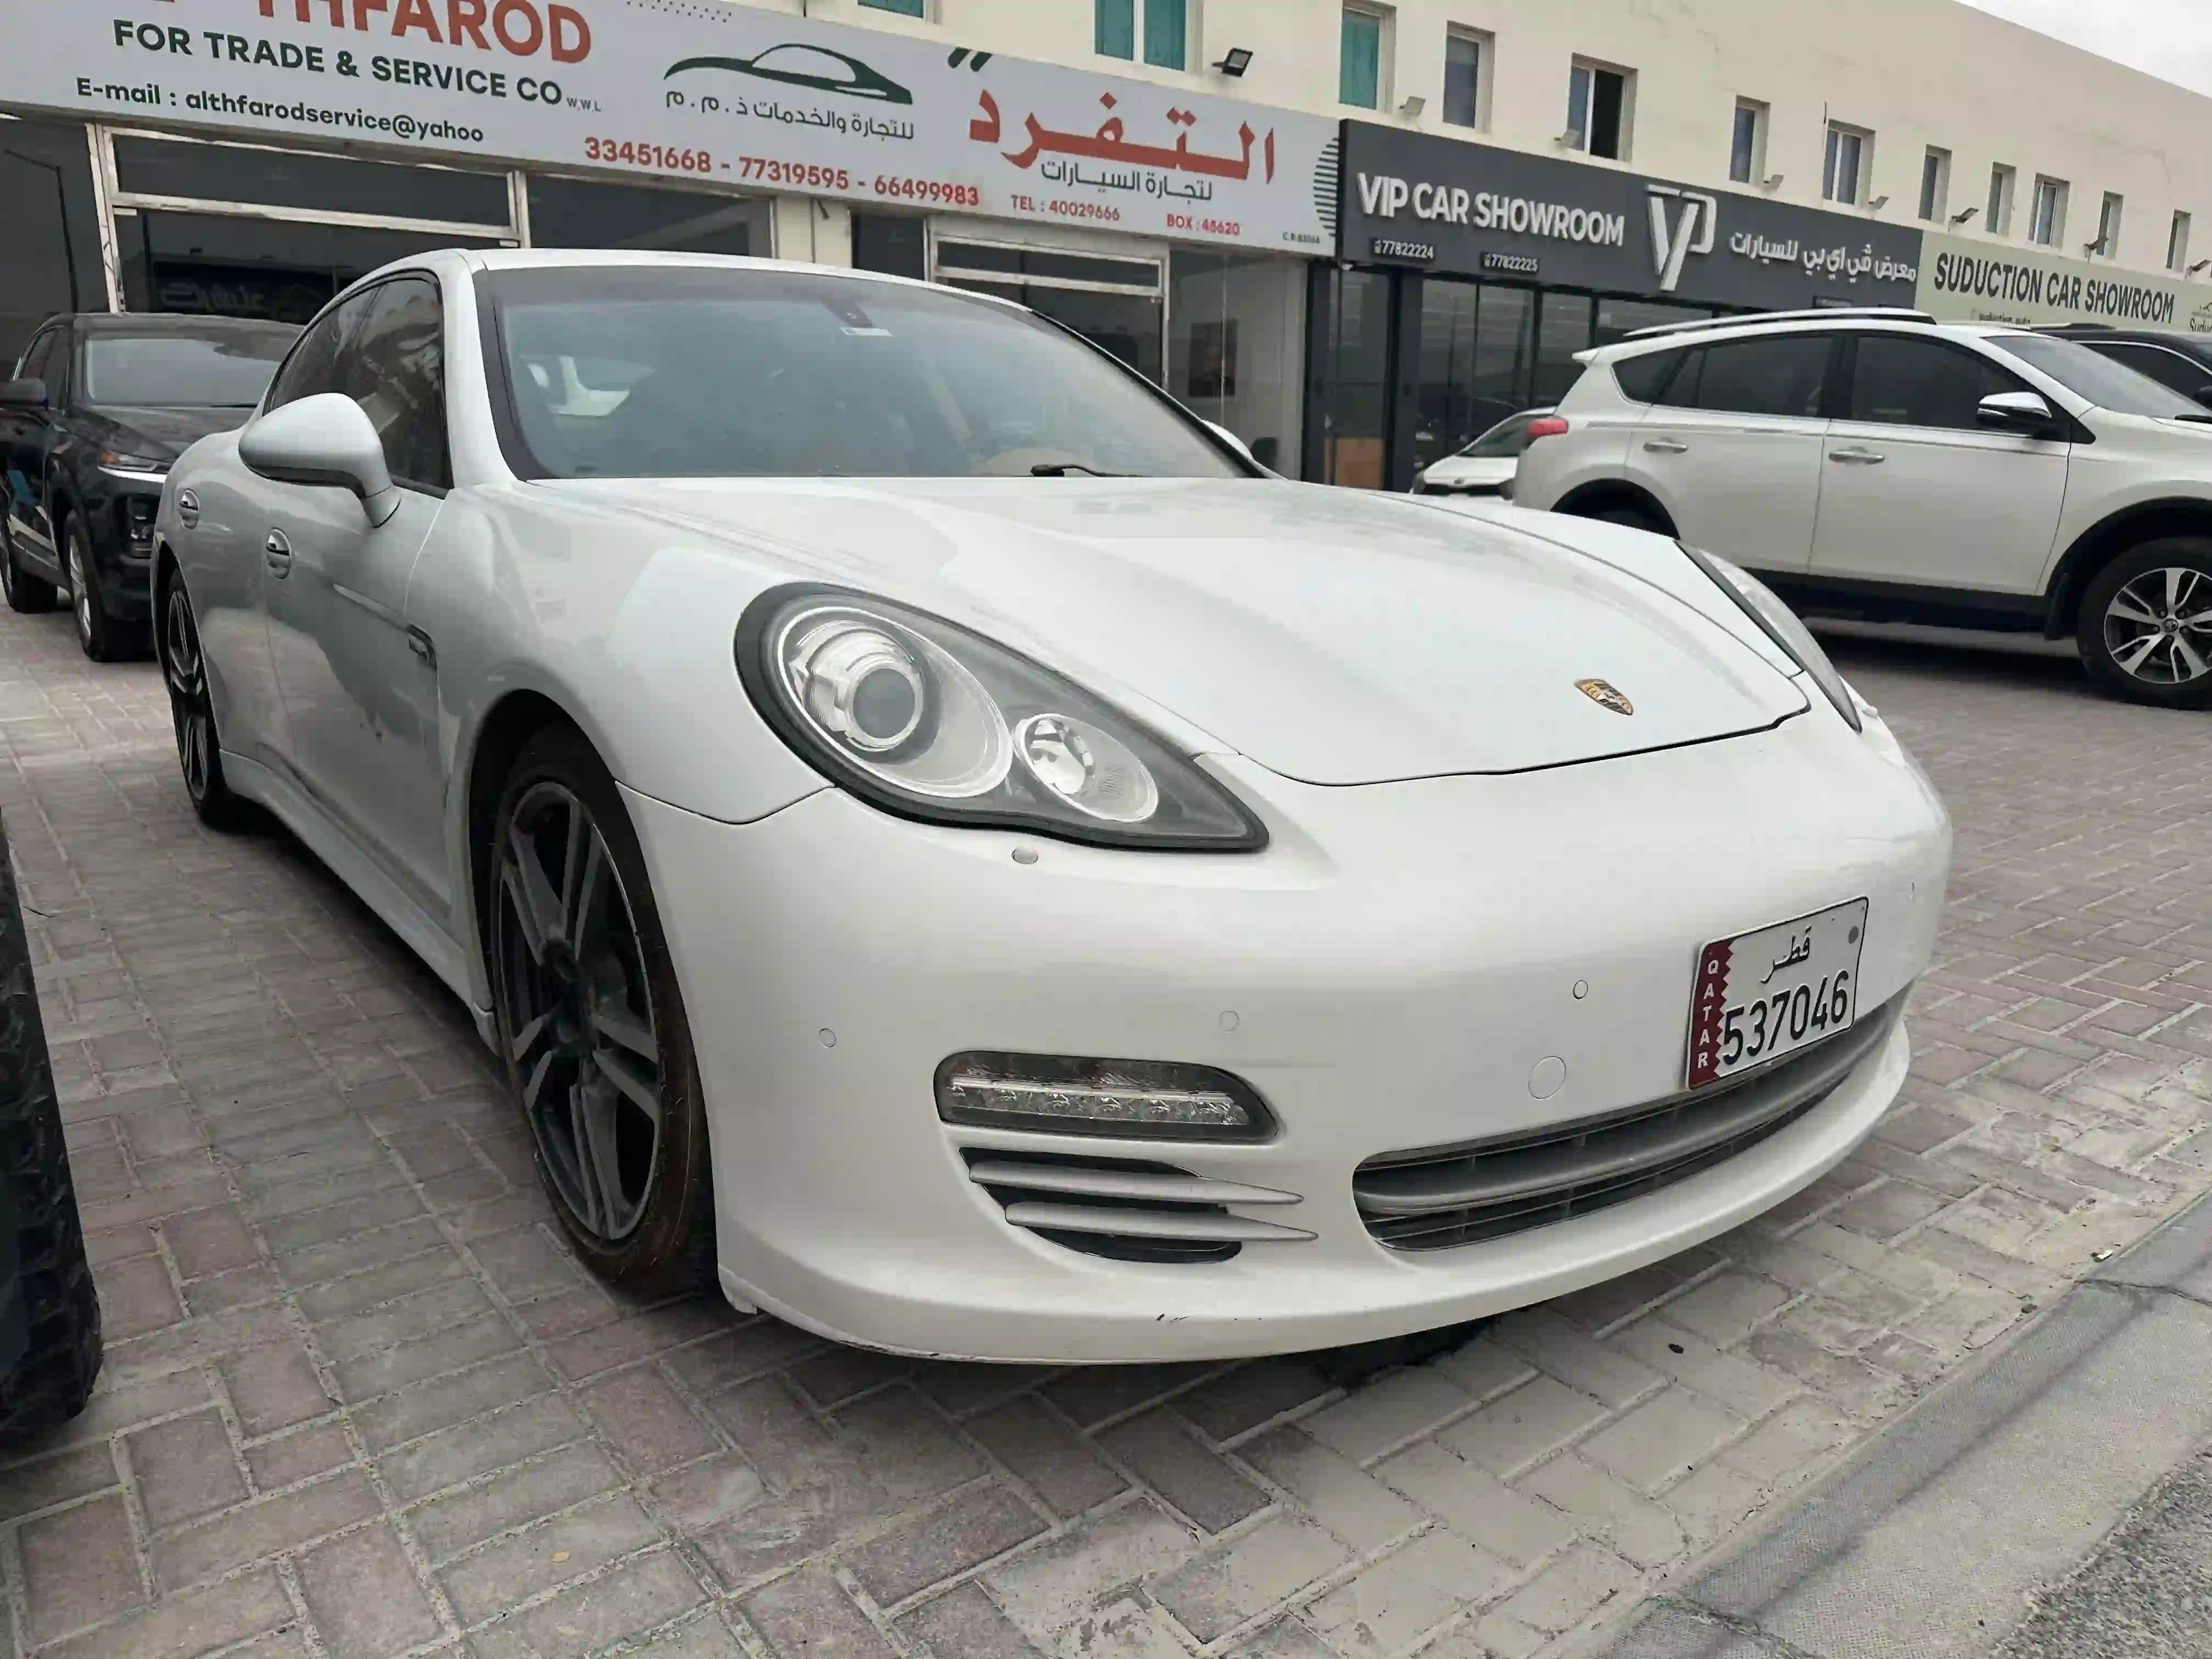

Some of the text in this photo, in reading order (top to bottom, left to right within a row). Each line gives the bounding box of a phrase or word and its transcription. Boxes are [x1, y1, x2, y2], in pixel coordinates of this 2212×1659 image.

[113, 19, 193, 56] FOR
[203, 31, 325, 73] TRADE
[336, 50, 360, 78] &
[372, 55, 507, 98] SERVICE
[516, 77, 562, 105] CO
[259, 0, 591, 64] FAROD
[76, 77, 161, 105] E-mail
[186, 91, 484, 142] althfarodservice@yahoo
[753, 102, 846, 133] والخدمات
[851, 113, 914, 142] للتجارة
[969, 88, 1275, 186] التفرد
[584, 136, 711, 173] 33451668
[739, 157, 850, 191] 77319595
[874, 175, 980, 206] 66499983
[1144, 173, 1213, 205] لتجارة
[1010, 194, 1036, 213] TEL
[1048, 200, 1121, 221] 40029666
[1166, 213, 1193, 230] BOX
[1356, 172, 1626, 248] VIP CAR SHOWROOM
[1729, 231, 1799, 265] للسيارات
[1874, 255, 1917, 282] معرض
[1934, 252, 2175, 324] SUDUCTION CAR SHOWROOM
[1759, 925, 1812, 985] قطر
[1697, 959, 1719, 1069] QATAR
[1722, 968, 1850, 1066] 537046
